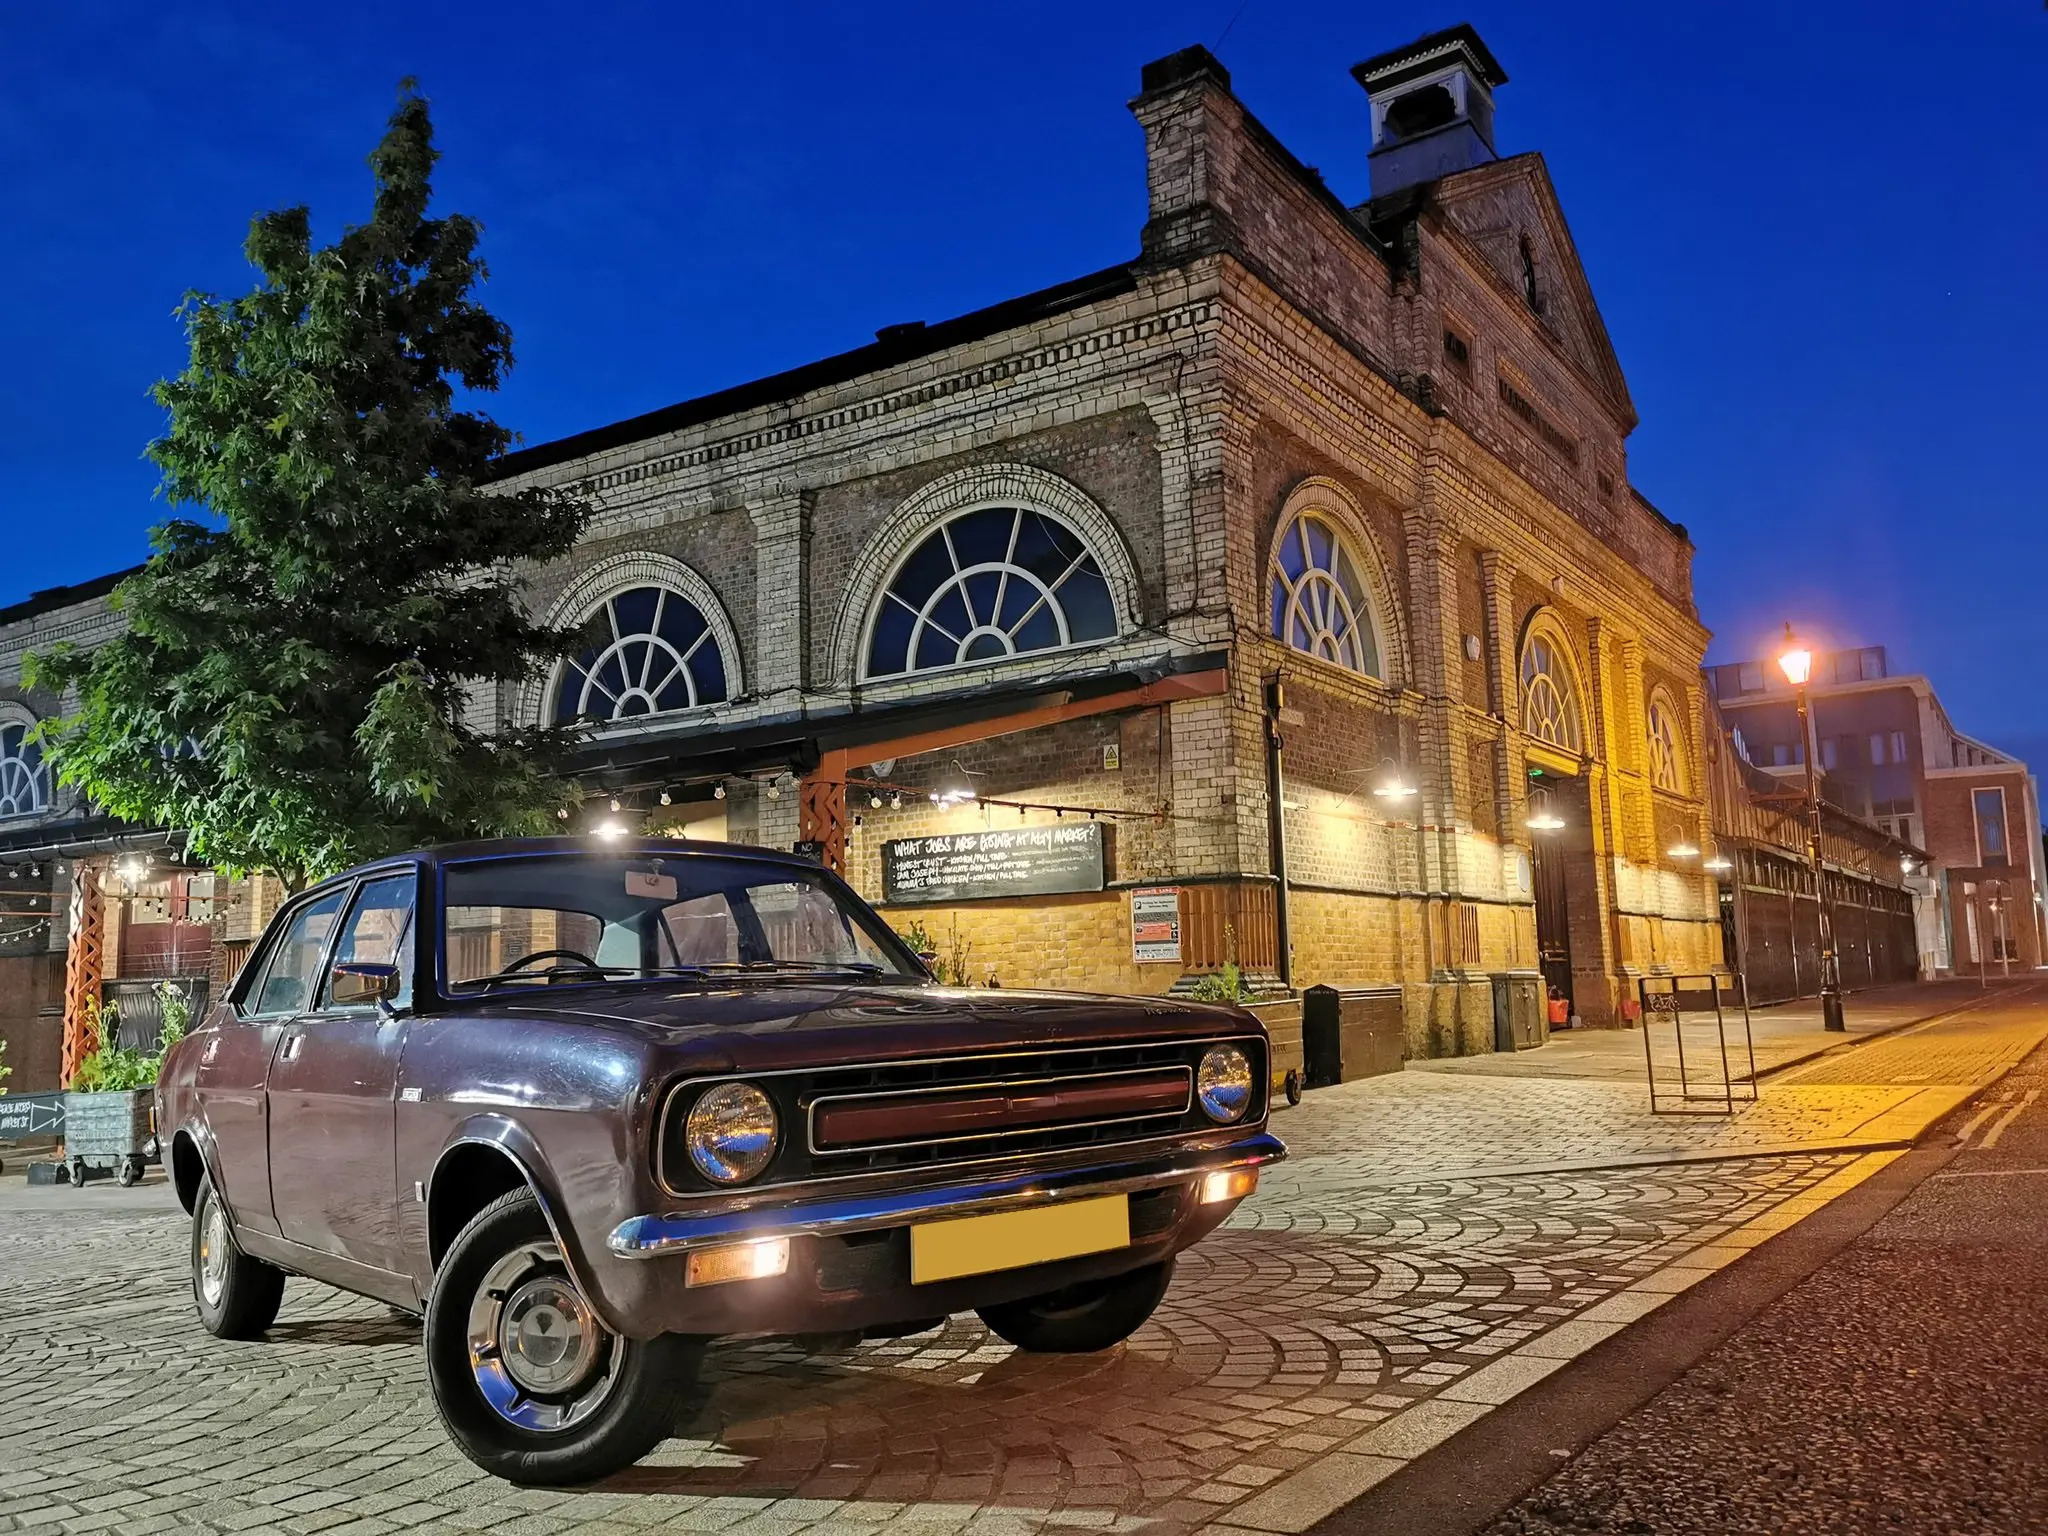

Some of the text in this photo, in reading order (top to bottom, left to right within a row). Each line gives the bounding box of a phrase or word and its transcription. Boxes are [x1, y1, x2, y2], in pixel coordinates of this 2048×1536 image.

[801, 843, 813, 852] NO
[894, 840, 923, 857] WHAT
[926, 836, 951, 854] JOBS
[955, 835, 977, 852] ARE
[980, 831, 1015, 852] GOING
[1016, 831, 1030, 846] AT
